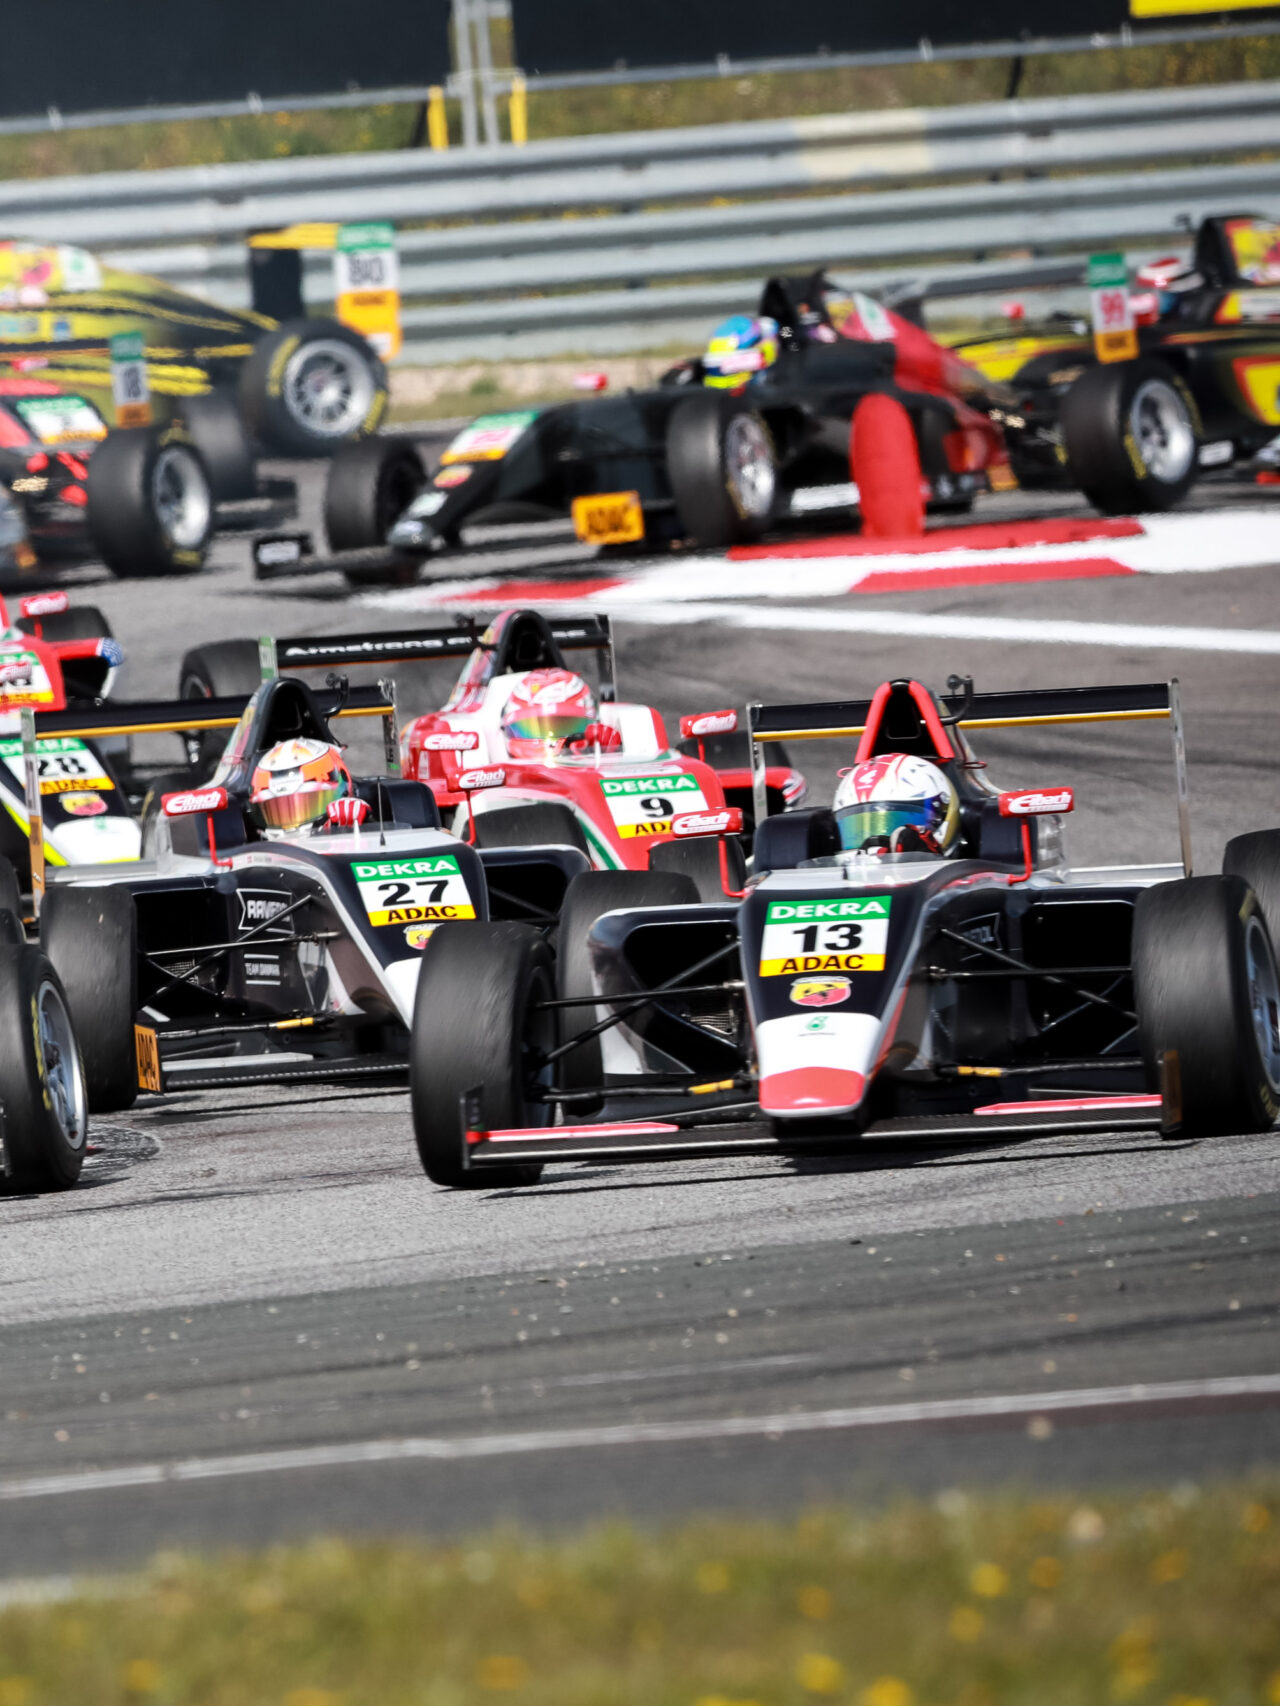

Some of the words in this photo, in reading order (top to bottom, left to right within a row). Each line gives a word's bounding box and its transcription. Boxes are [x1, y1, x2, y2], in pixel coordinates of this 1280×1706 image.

[459, 769, 505, 788] Eibach
[603, 776, 696, 795] DEKRA
[166, 791, 222, 811] Eibach
[641, 797, 674, 818] 9
[634, 821, 672, 836] AD
[357, 859, 456, 877] DEKRA
[377, 879, 450, 907] 27
[387, 905, 459, 922] ADAC
[771, 901, 887, 919] DEKRA
[792, 923, 863, 953] 13
[780, 954, 864, 973] ADAC
